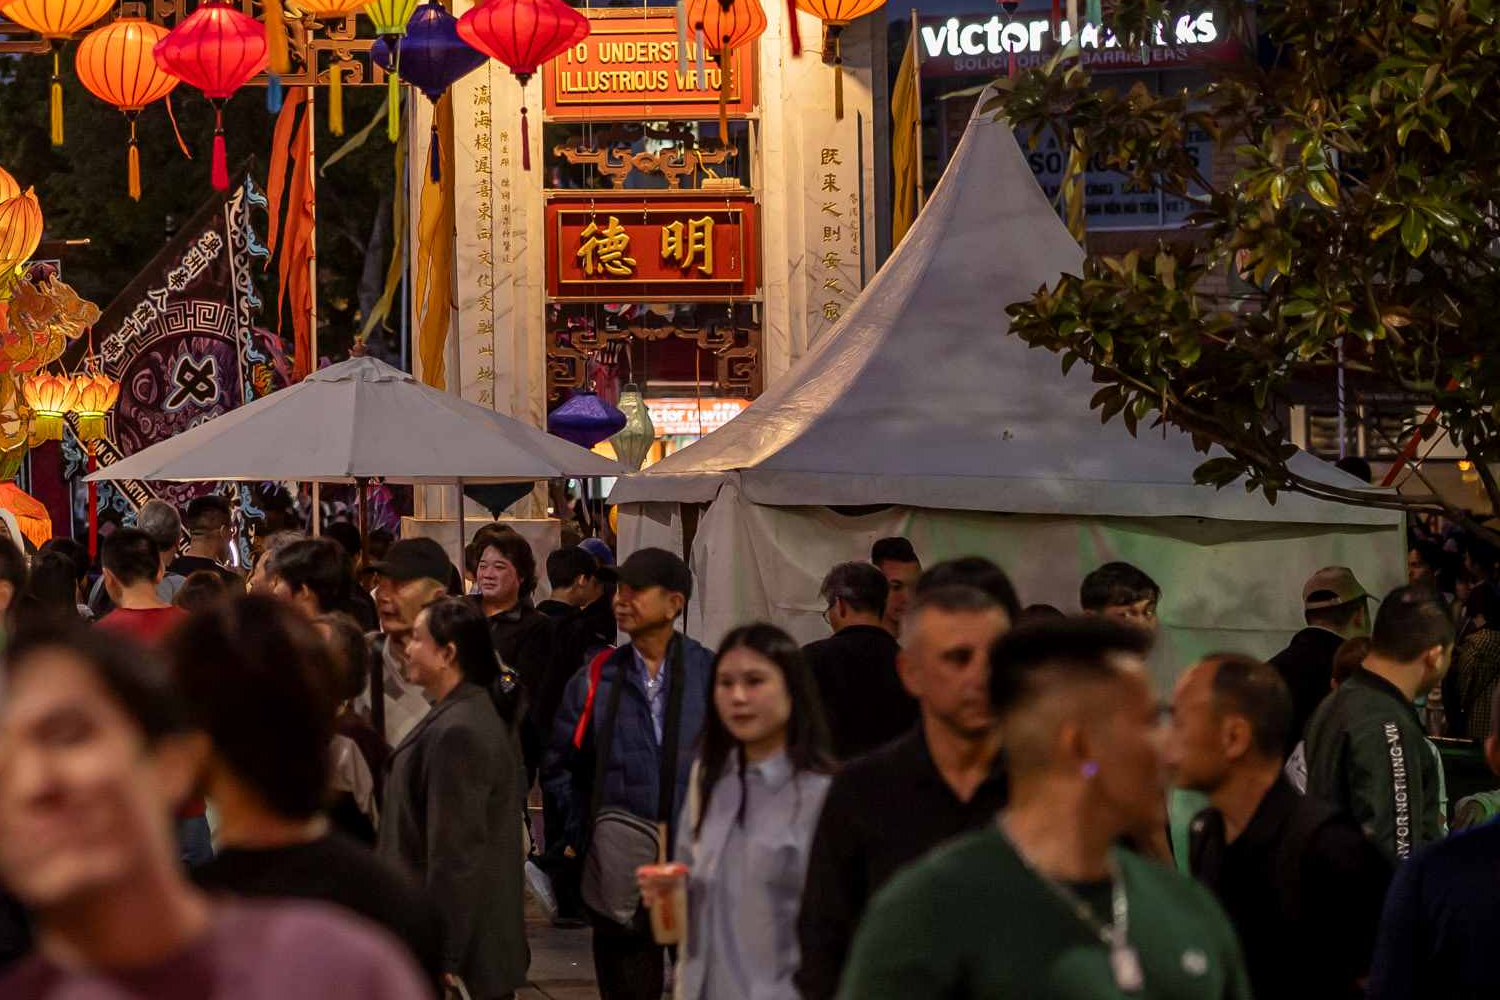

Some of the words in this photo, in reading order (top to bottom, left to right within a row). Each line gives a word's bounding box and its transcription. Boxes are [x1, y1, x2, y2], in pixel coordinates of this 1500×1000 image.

[921, 16, 1049, 57] victor
[567, 42, 588, 64] TO
[953, 54, 1051, 71] SOLICIORS
[1080, 48, 1189, 65] BARRISERS
[562, 70, 668, 92] ILLUSTRIOUS
[675, 69, 735, 91] VIRTU
[122, 479, 150, 506] ARTIA
